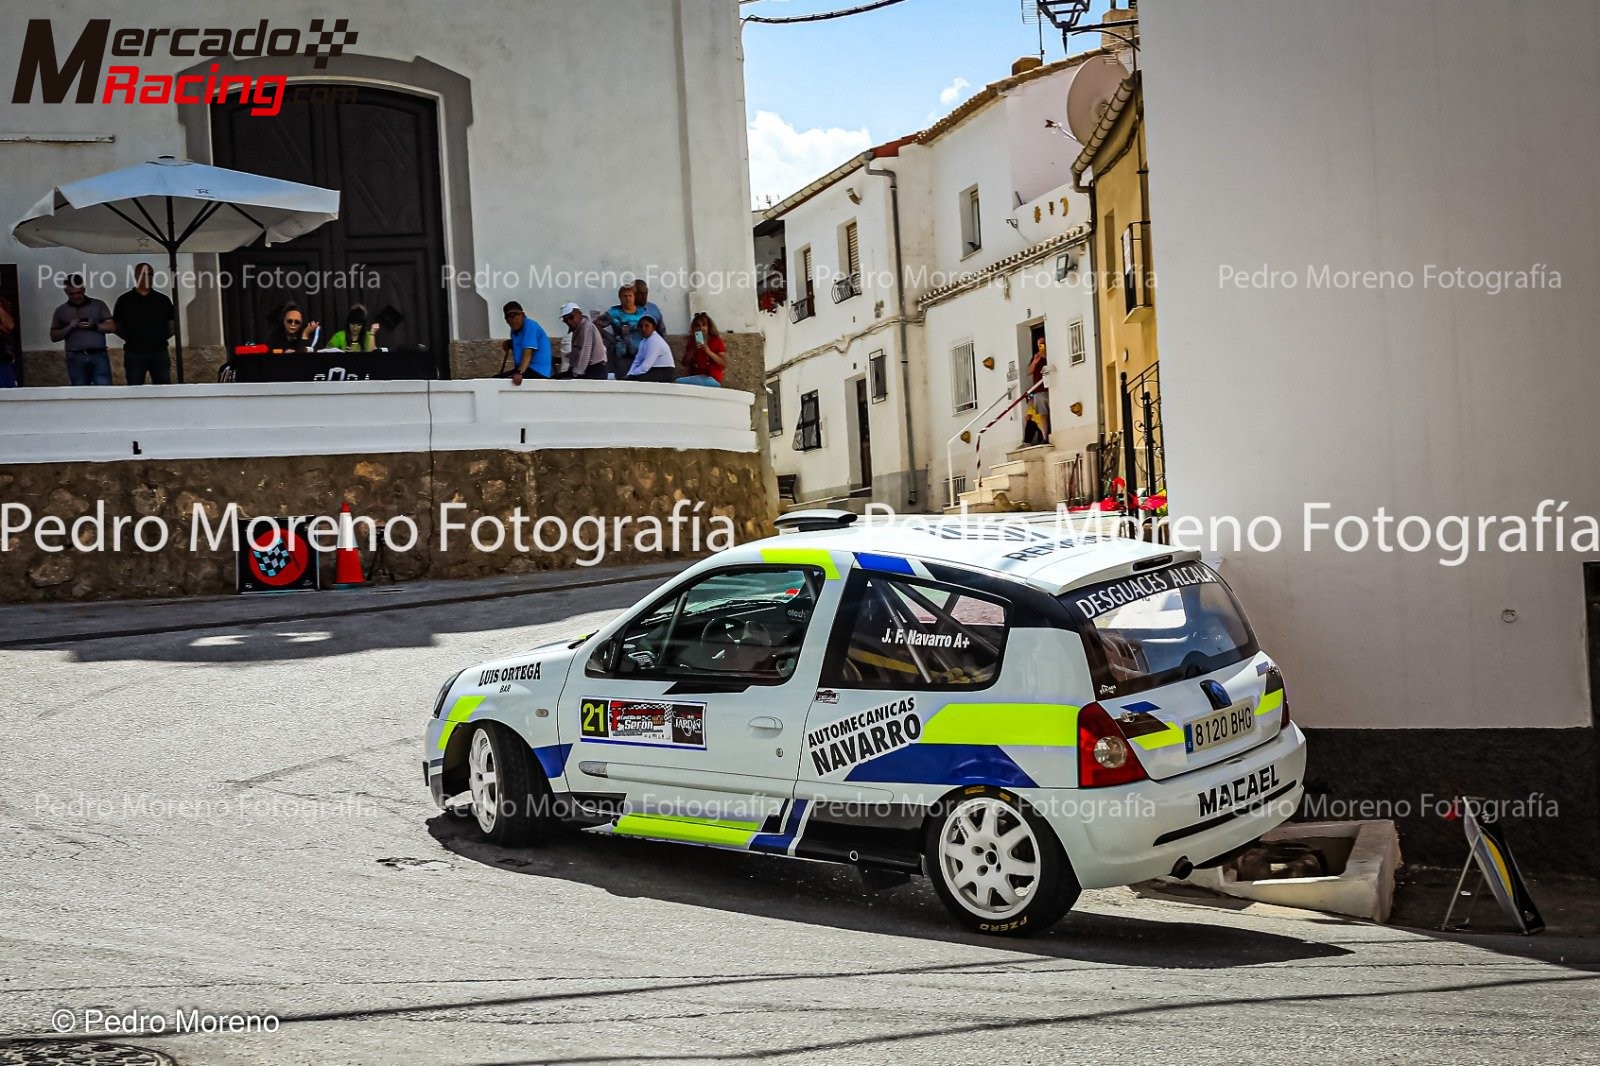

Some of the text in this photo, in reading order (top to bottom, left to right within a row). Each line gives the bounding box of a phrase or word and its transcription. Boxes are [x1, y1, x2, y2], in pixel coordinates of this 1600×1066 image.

[1075, 565, 1217, 619] DESGUACES ALCALA
[881, 628, 970, 649] J. F. Navarro A+
[478, 661, 541, 687] LUIS ORTEGA
[499, 684, 511, 694] BAR
[582, 702, 605, 733] 21
[807, 697, 915, 748] AUTOMECANICAS
[1195, 707, 1252, 747] 8120 BHG
[810, 713, 921, 776] NAVARRO
[1197, 764, 1280, 818] MACAEL
